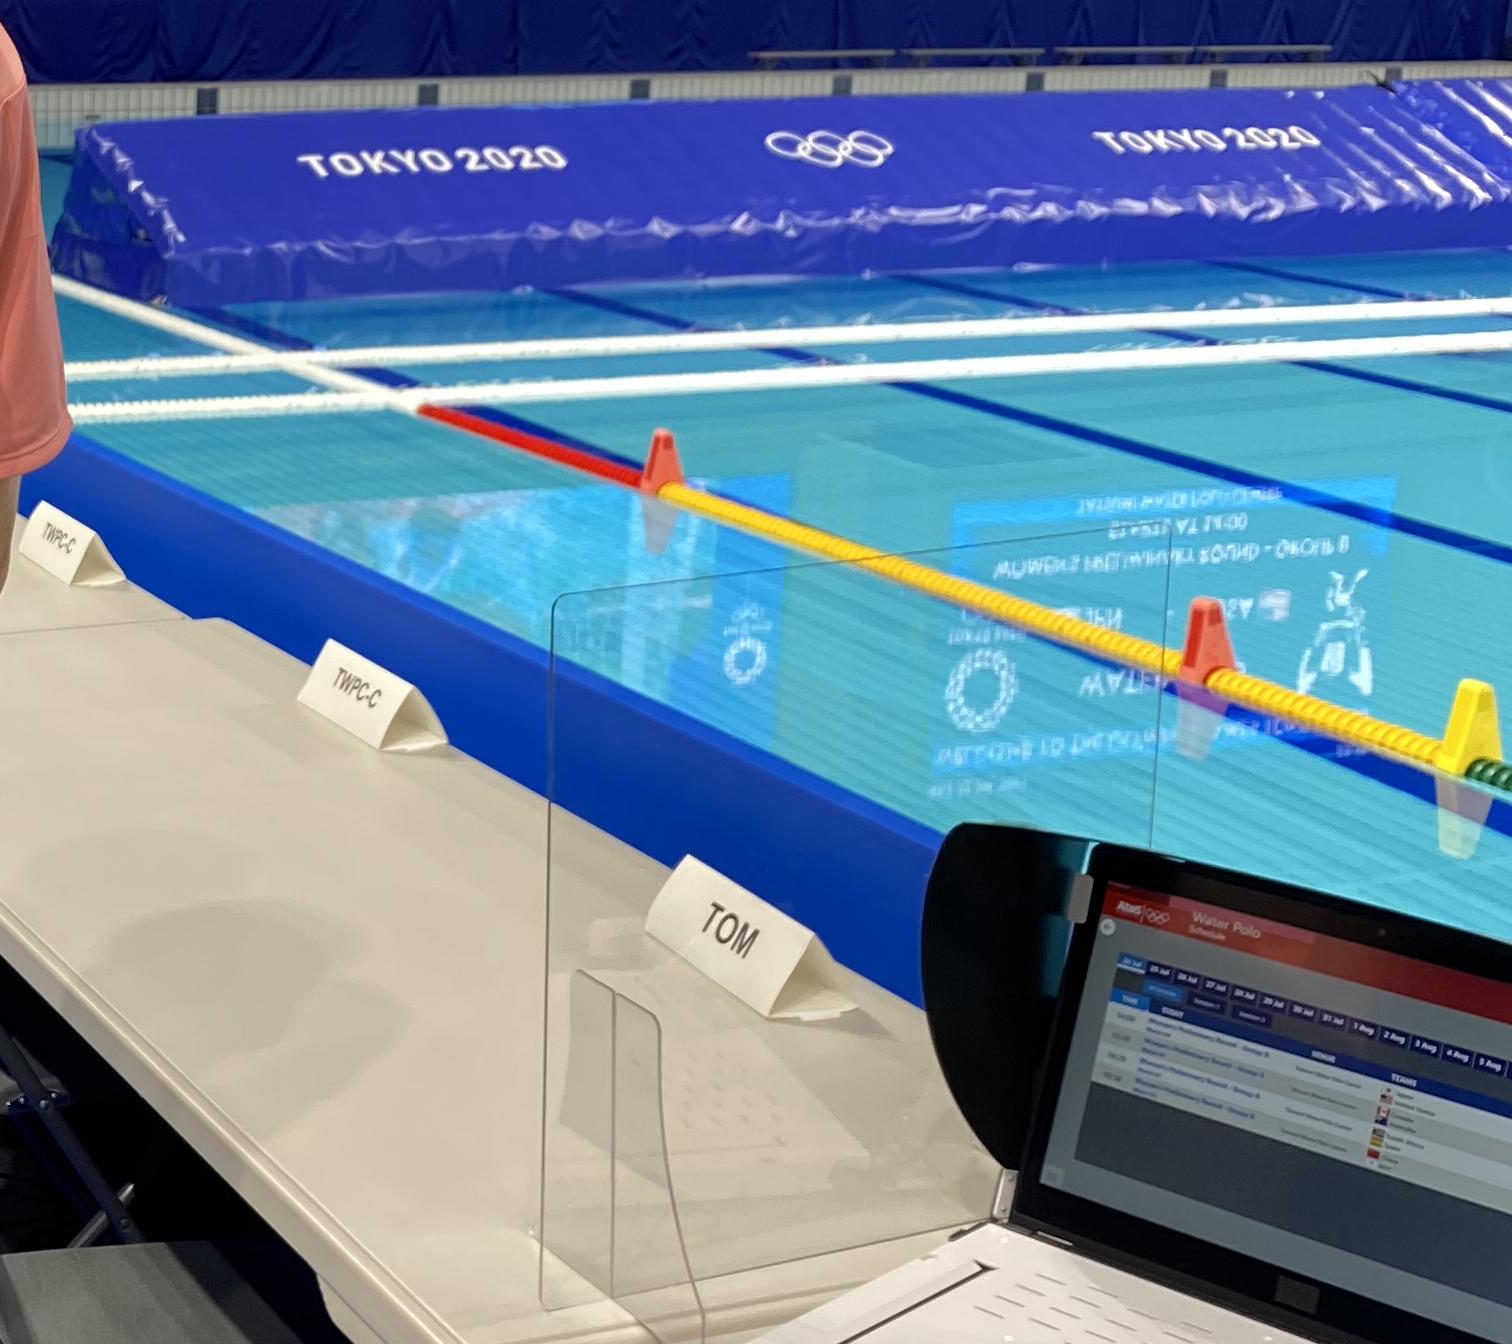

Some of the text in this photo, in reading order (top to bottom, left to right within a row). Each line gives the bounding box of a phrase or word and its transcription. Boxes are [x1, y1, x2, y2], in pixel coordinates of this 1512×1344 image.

[1092, 125, 1321, 155] TOKYO 2020
[296, 144, 569, 179] TOKYO 2020
[42, 522, 78, 555] TWPC-C
[332, 665, 383, 710] TWPC-C
[700, 900, 761, 959] TOM
[1192, 911, 1262, 939] Water Polo
[1391, 1072, 1418, 1087] TEAMS
